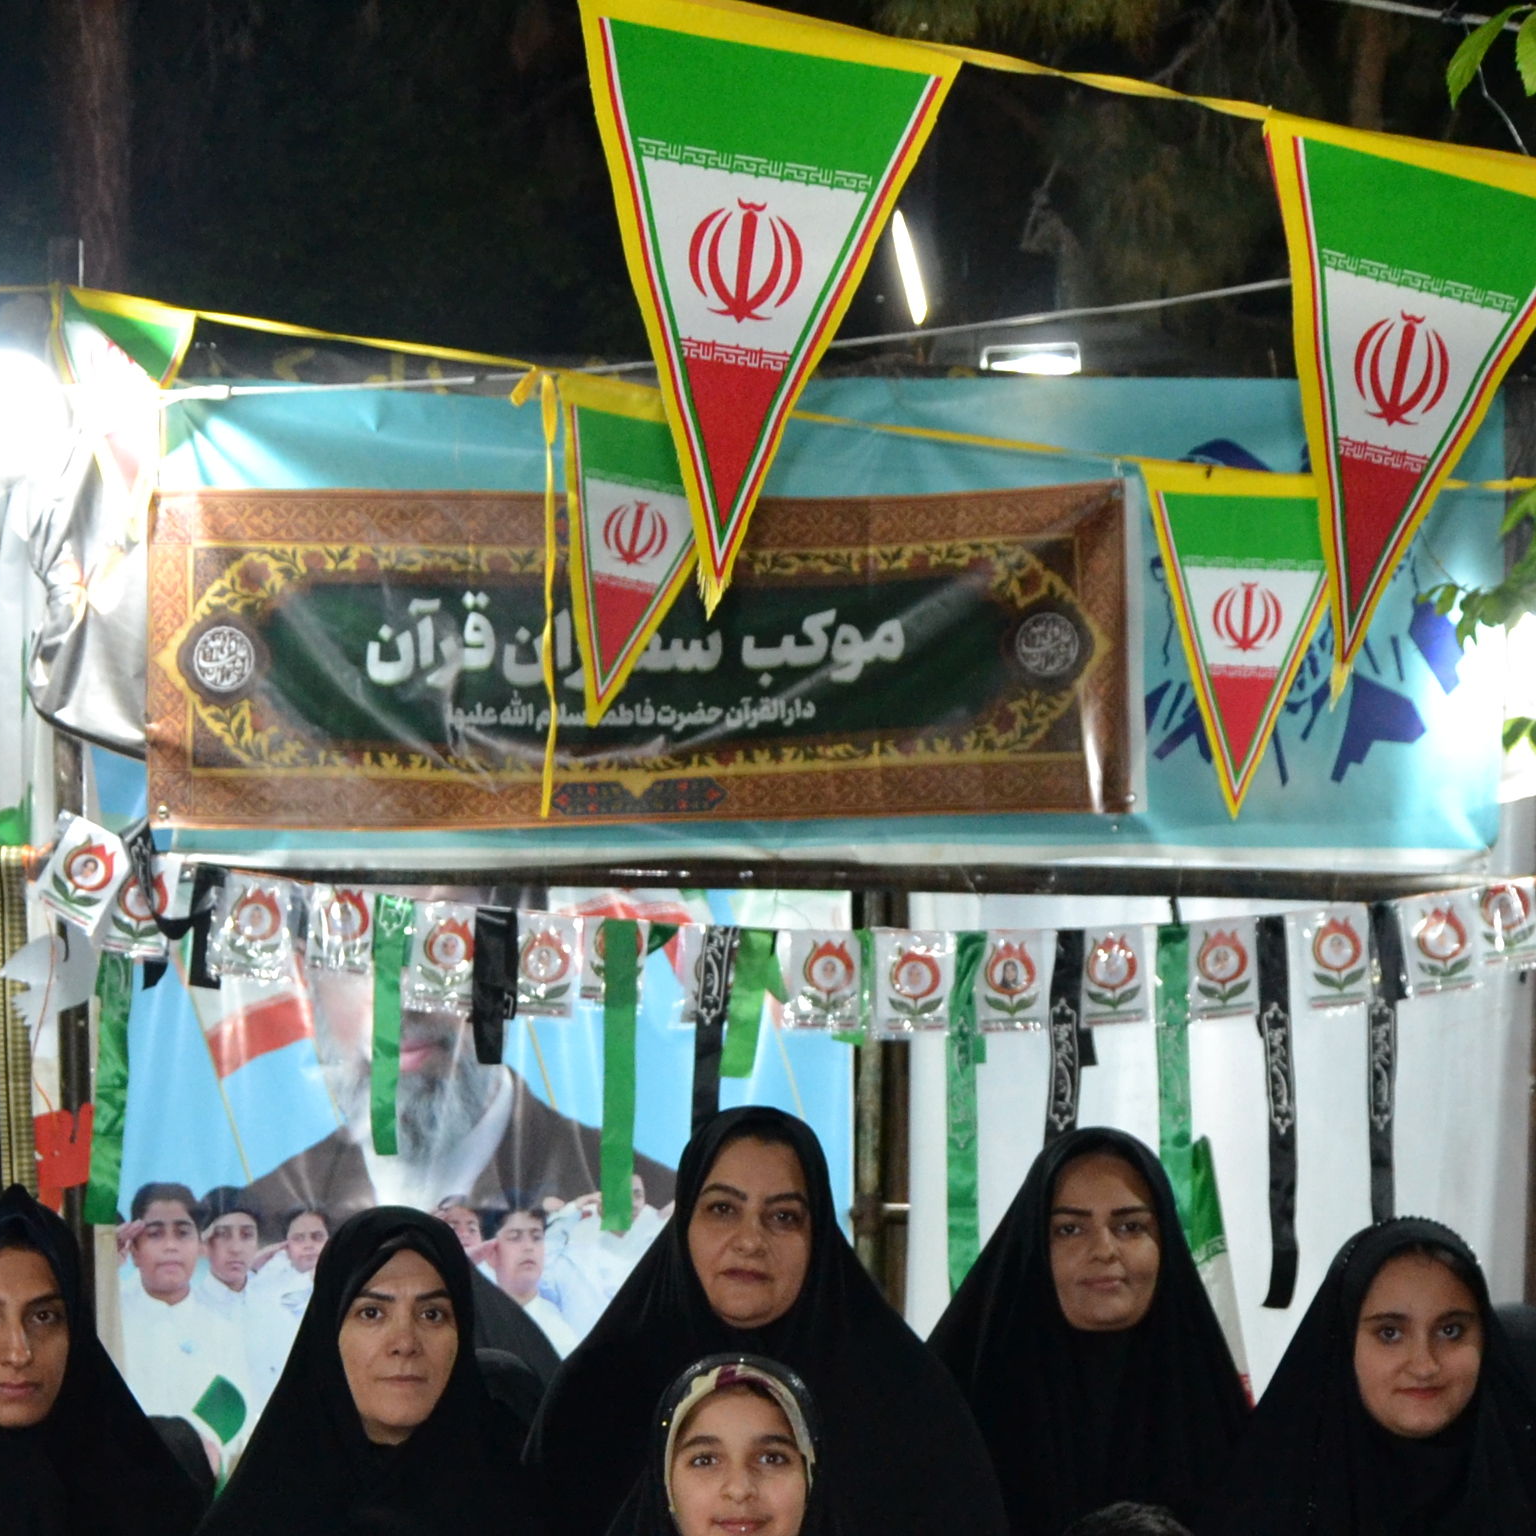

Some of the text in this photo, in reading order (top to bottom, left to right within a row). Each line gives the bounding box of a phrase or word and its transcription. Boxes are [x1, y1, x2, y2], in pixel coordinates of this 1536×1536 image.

[366, 590, 905, 691] موکب سران قرآن
[500, 690, 534, 725] الله
[600, 698, 655, 728] فاطم
[656, 701, 723, 732] حضرت
